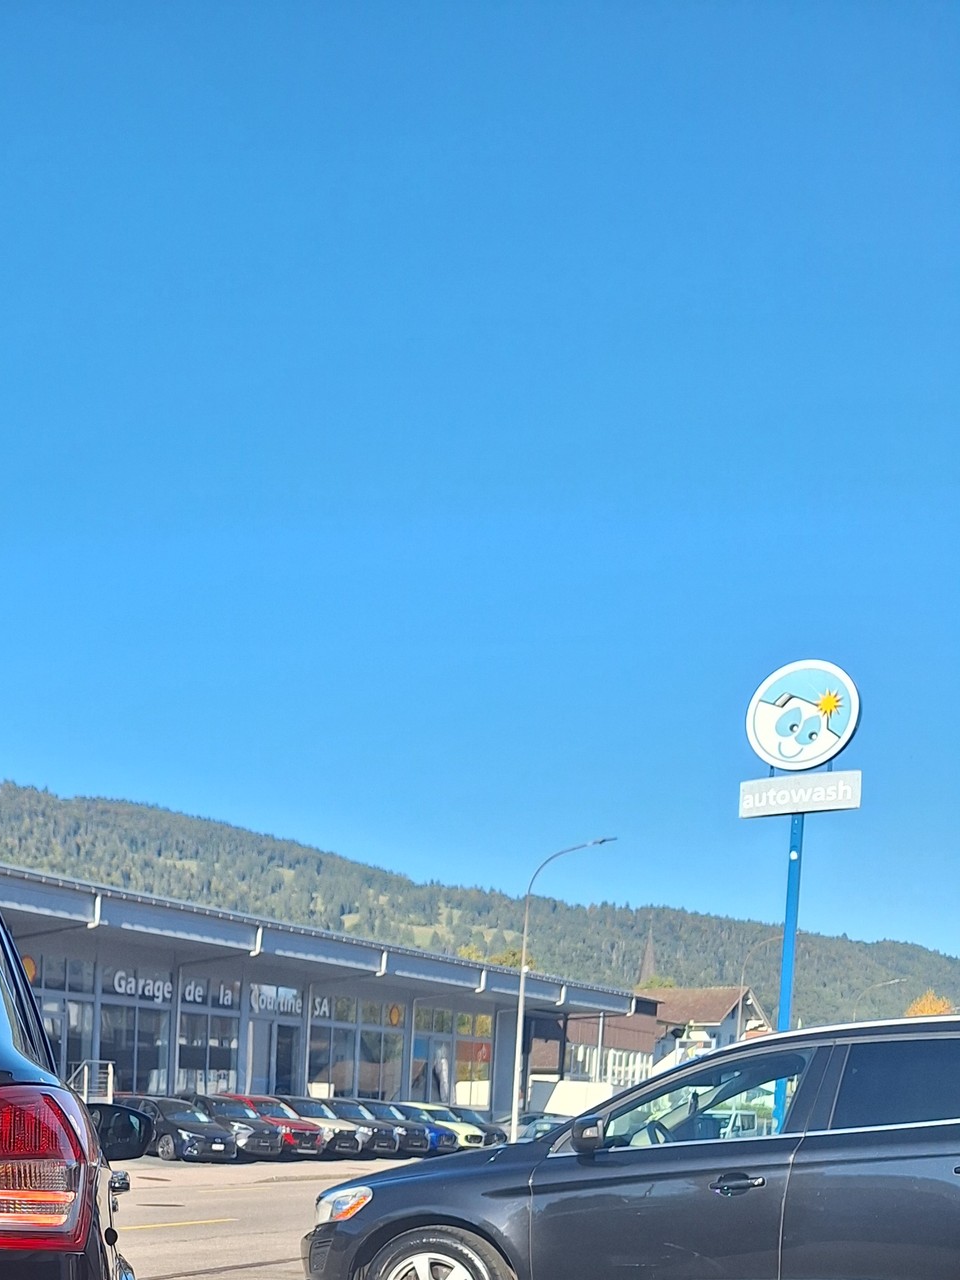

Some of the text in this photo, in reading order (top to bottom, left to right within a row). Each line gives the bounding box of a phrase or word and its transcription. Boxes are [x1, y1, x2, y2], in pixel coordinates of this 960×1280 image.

[743, 780, 852, 809] autowash
[113, 969, 172, 1004] Garage
[185, 980, 203, 1003] de
[219, 984, 232, 1007] la
[313, 997, 329, 1017] SA
